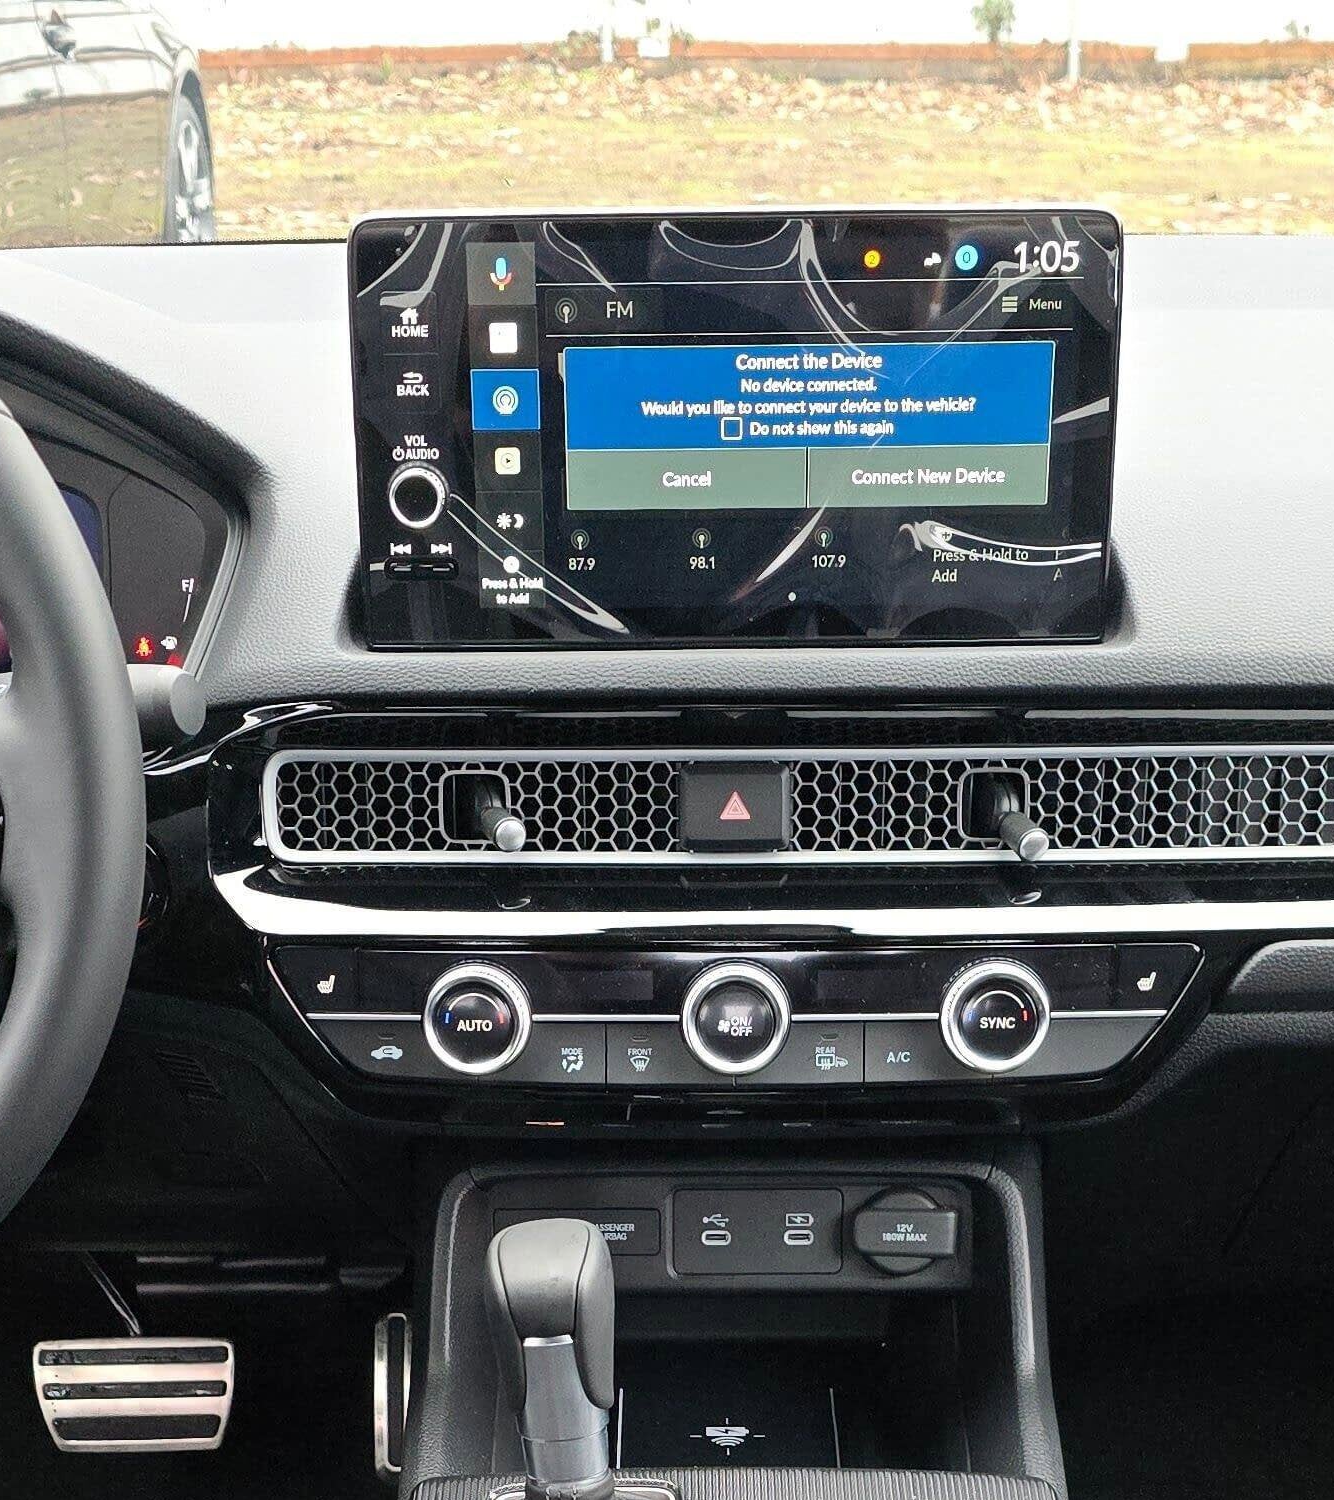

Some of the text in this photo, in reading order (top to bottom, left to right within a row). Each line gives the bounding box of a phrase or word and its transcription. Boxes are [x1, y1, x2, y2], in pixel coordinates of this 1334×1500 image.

[1014, 240, 1080, 273] 1:05
[606, 301, 634, 319] FM
[1028, 299, 1062, 311] Menu
[391, 325, 429, 338] HOME
[735, 352, 883, 370] Connect the Device
[396, 384, 430, 397] BACK
[740, 377, 877, 392] No device connected.
[641, 397, 977, 417] Would you like to connect your device to the vehicle?
[750, 420, 894, 437] Do not show this again
[404, 434, 428, 447] VOL
[405, 448, 440, 460] AUDIO
[662, 470, 712, 487] Cancel
[851, 468, 1005, 484] Connect New Device
[811, 555, 846, 569] 107.9
[933, 549, 1028, 562] Press & Hold to
[568, 557, 596, 571] 87.9
[689, 557, 715, 570] 98.1
[931, 569, 958, 582] Add
[495, 593, 530, 604] to Add
[456, 1019, 493, 1032] AUTO
[979, 1017, 1016, 1029] SYNC
[730, 1026, 753, 1037] OFF
[561, 1047, 583, 1056] MODE
[627, 1048, 652, 1056] FRONT
[815, 1046, 835, 1054] REAR
[887, 1052, 911, 1063] A/C
[594, 1223, 635, 1232] ASSENGER
[896, 1223, 914, 1233] 12V
[906, 1233, 928, 1242] MAX
